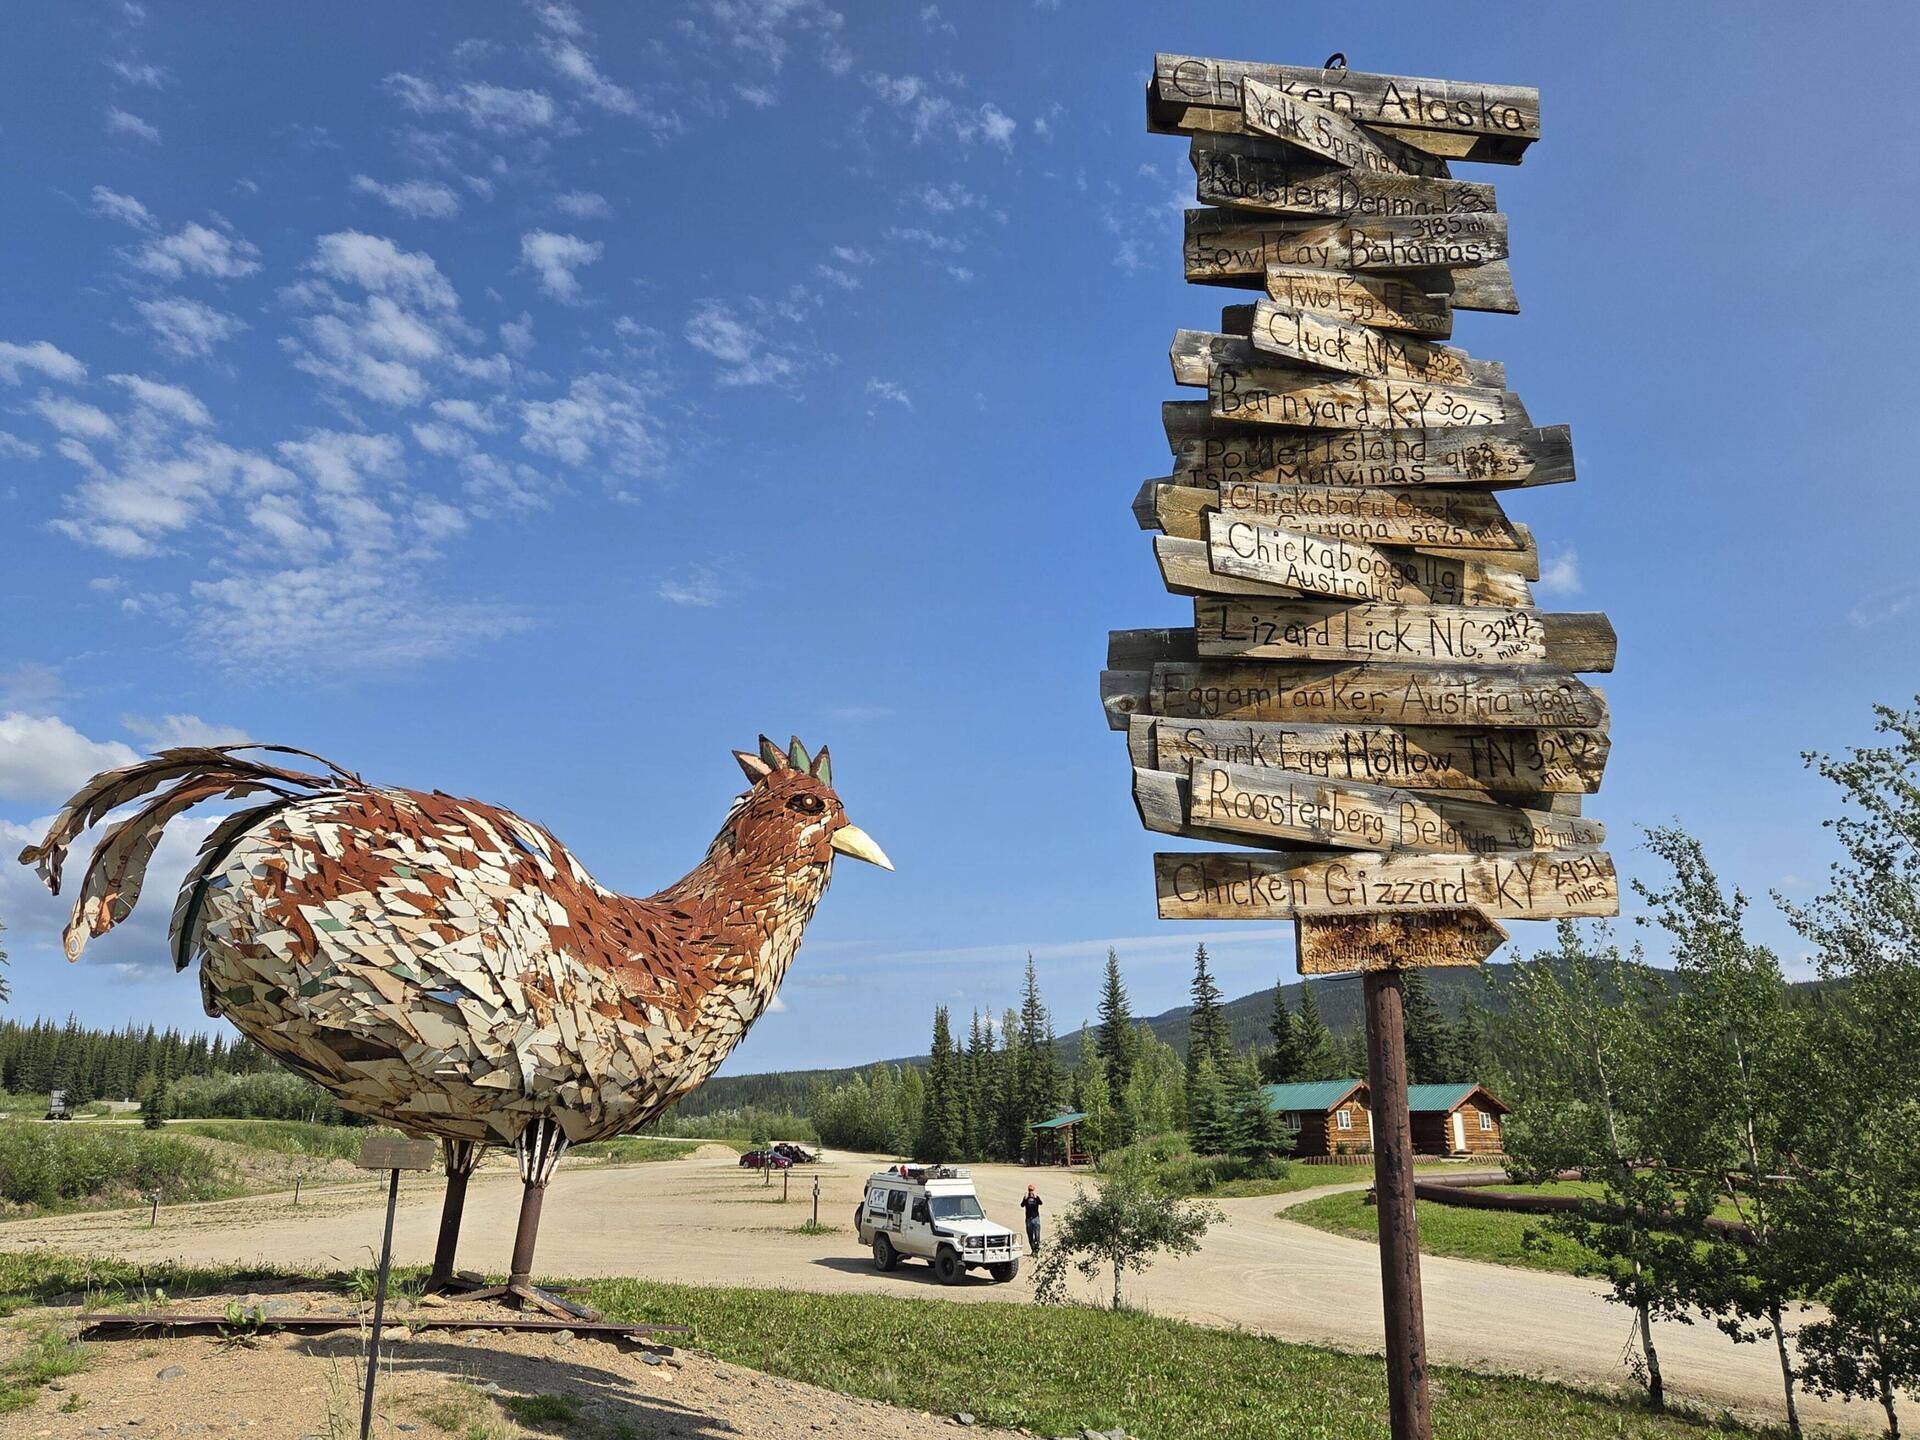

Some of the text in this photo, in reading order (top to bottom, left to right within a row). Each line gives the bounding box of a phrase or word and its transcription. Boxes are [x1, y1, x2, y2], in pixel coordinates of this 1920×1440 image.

[1250, 87, 1313, 143] Yolk
[1378, 82, 1527, 132] Alaska
[1410, 215, 1462, 238] 3985
[1197, 233, 1267, 268] Fowl
[1350, 228, 1482, 268] Bahamas
[1276, 275, 1332, 308] Two
[1387, 386, 1432, 429] KY
[1321, 431, 1426, 464] Island
[1231, 484, 1388, 517] Chickabaru
[1408, 525, 1463, 544] 5675
[1286, 563, 1400, 602] Australia
[1221, 605, 1535, 659] Lizard Lick, N.C. 3242
[1497, 639, 1531, 661] miles
[1401, 674, 1513, 717] Austria
[1539, 710, 1588, 727] miles
[1280, 730, 1329, 778] Egg
[1343, 728, 1452, 779] Hollow
[1456, 733, 1516, 779] TN
[1527, 731, 1595, 772] 3242
[1210, 768, 1385, 845] Roosterberg
[1173, 854, 1602, 910] Chicken Gizzard KY 2951
[1564, 881, 1609, 908] miles
